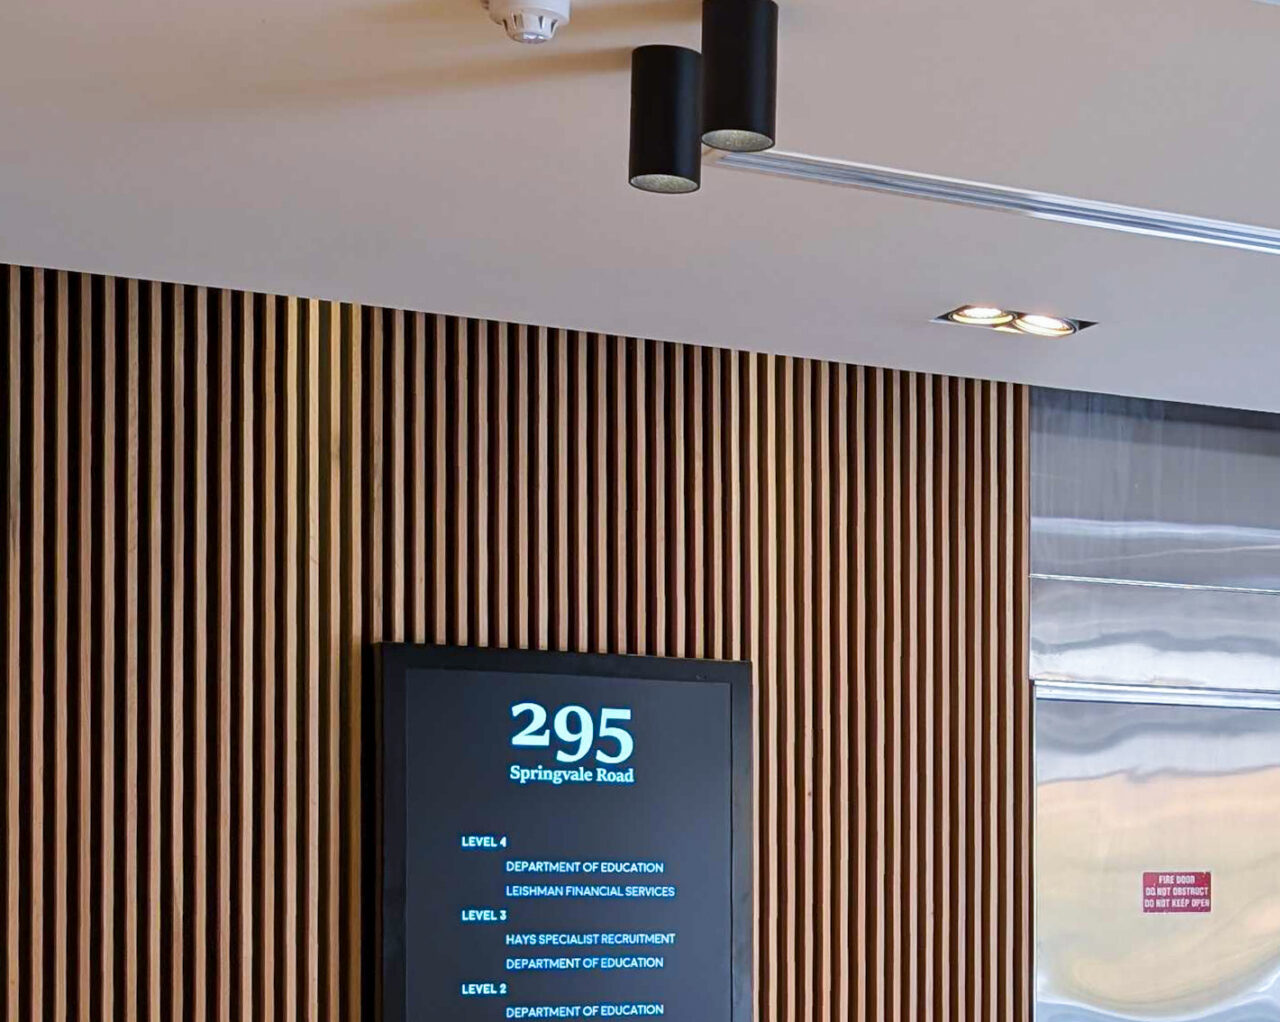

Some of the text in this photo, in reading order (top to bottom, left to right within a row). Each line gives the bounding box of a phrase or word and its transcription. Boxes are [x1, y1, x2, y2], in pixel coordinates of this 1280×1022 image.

[511, 702, 634, 764] 295
[510, 765, 635, 784] Springvale Road
[461, 836, 507, 848] LEVEL 4
[506, 861, 664, 873] DEPARTMENT OF EDUCATION
[1159, 875, 1195, 884] FIRE DOOR
[506, 885, 676, 897] LEISHMAN FINANCIAL SERVICES
[1145, 886, 1209, 896] DO NOT OBSTRUCT
[1144, 898, 1210, 908] DO NOT KEEP OPEN
[461, 910, 507, 921] LEVEL 3
[506, 932, 676, 945] HAYS SPECIALIST RECRUITMENT
[506, 957, 664, 970] DEPARTMENT OF EDUCATION
[461, 983, 507, 995] LEVEL 2
[506, 1004, 664, 1019] DEPARTMENT OF EDUCATION
